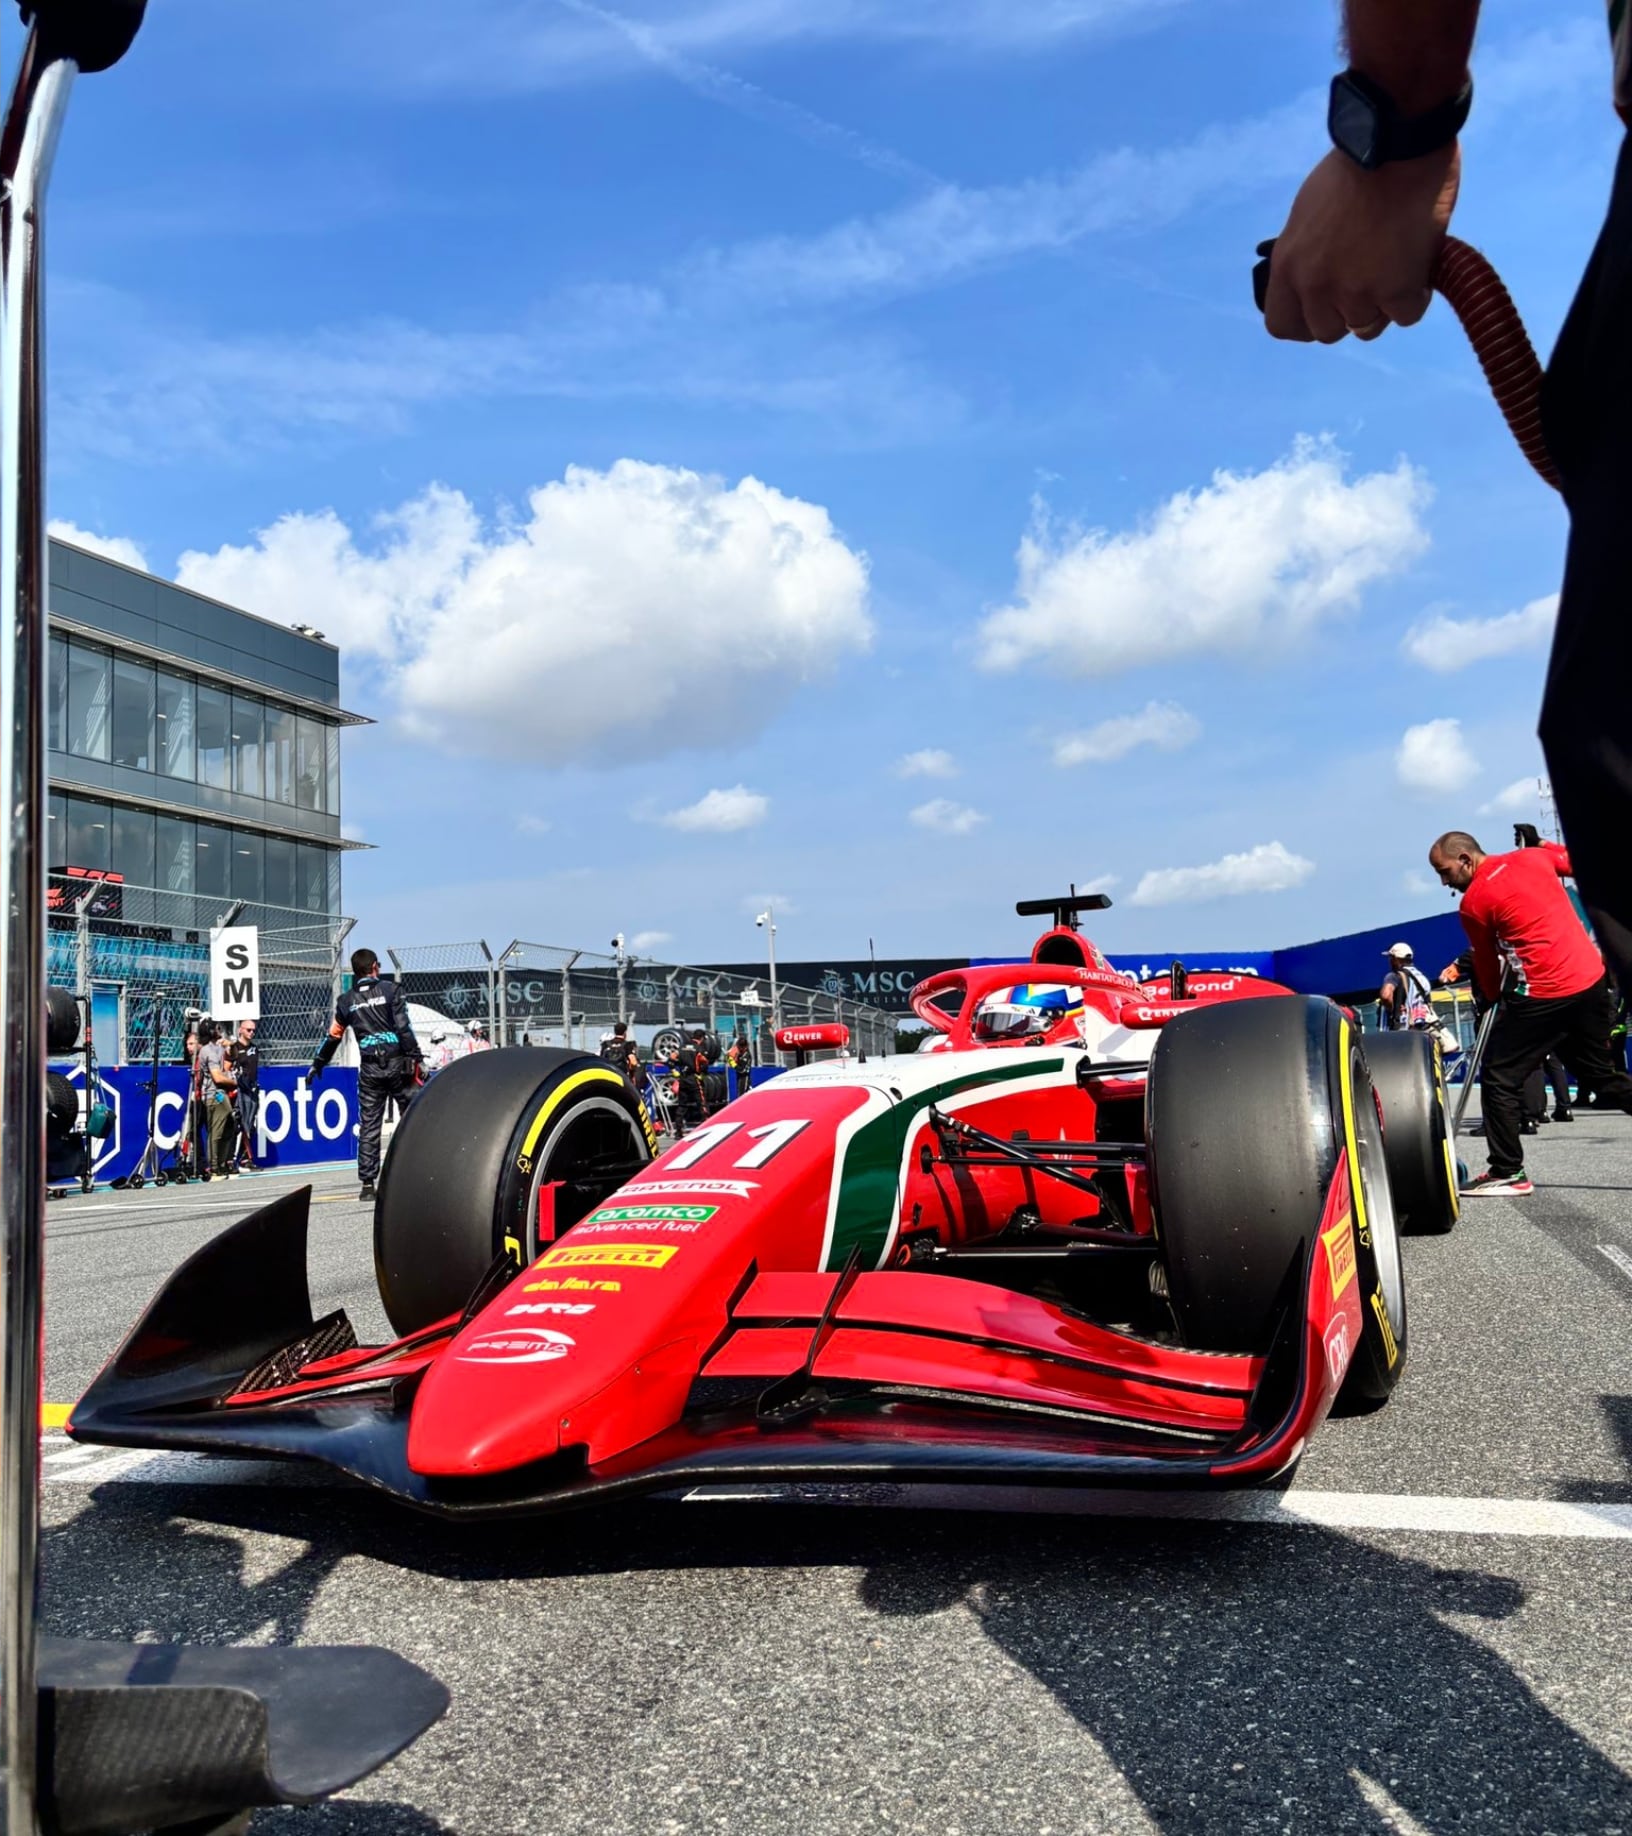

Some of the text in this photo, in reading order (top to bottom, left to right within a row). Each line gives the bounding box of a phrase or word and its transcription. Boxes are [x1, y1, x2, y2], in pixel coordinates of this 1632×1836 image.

[852, 970, 916, 994] MSC
[477, 980, 545, 1004] MSC
[662, 1119, 814, 1171] 11
[622, 1182, 739, 1194] RAVENOL
[595, 1206, 709, 1221] aramco
[572, 1219, 701, 1236] advanced fuel
[548, 1248, 666, 1264] PIRELLI
[522, 1277, 622, 1293] dallara
[467, 1340, 568, 1353] PREMA
